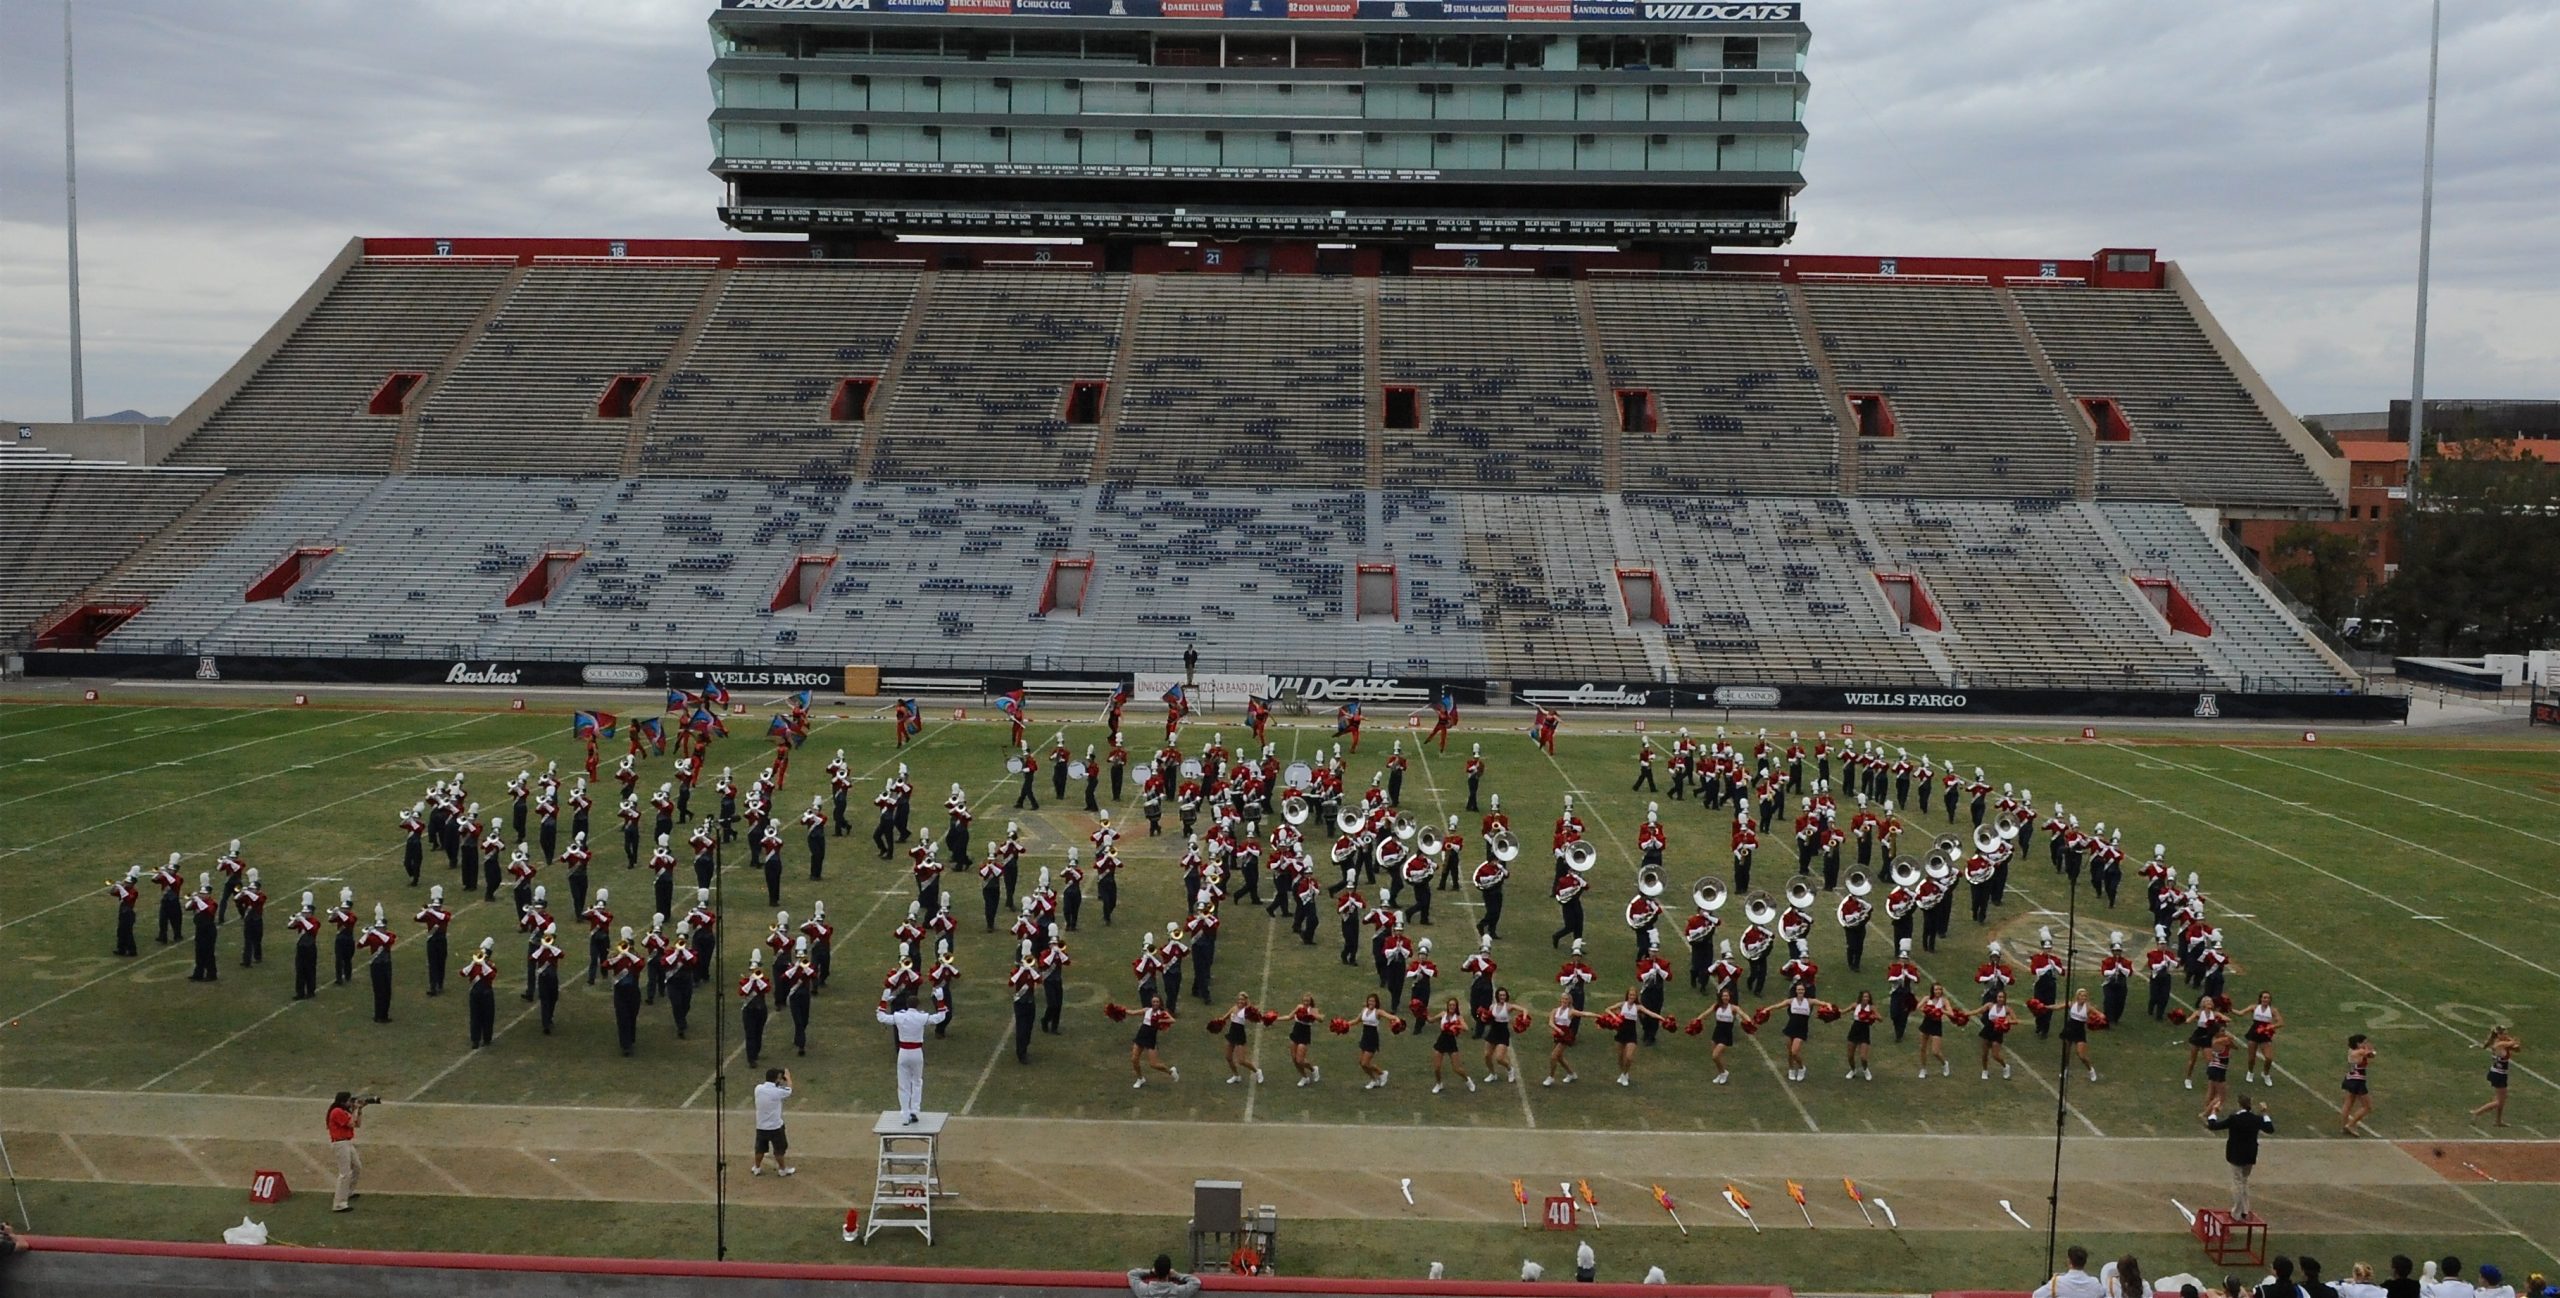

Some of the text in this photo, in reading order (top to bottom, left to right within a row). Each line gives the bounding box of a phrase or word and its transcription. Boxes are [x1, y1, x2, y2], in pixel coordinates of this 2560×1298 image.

[982, 0, 1010, 8] HUNLEY
[1017, 0, 1022, 8] 6
[1050, 1, 1072, 9] CECIL
[1161, 2, 1167, 10] 4
[1315, 4, 1350, 12] WALDROP
[1535, 5, 1571, 13] McALISTER
[1645, 5, 1792, 19] WILDCATS
[437, 246, 448, 255] 17
[611, 247, 624, 256] 18
[811, 249, 822, 259] 19
[1036, 252, 1050, 261] 20
[1206, 254, 1219, 264] 21
[1465, 258, 1478, 267] 22
[1881, 265, 1895, 274] 24
[2042, 268, 2056, 278] 25
[20, 428, 31, 437] 16
[445, 662, 520, 684] Bashas'
[709, 672, 830, 686] WELLS FARGO
[1226, 683, 1247, 693] BAND
[1249, 684, 1263, 694] DAY
[1844, 693, 1967, 707] WELLS FARGO
[2337, 1001, 2514, 1030] 20
[253, 1175, 275, 1198] 40
[905, 1189, 922, 1208] 50
[1548, 1202, 1571, 1225] 40
